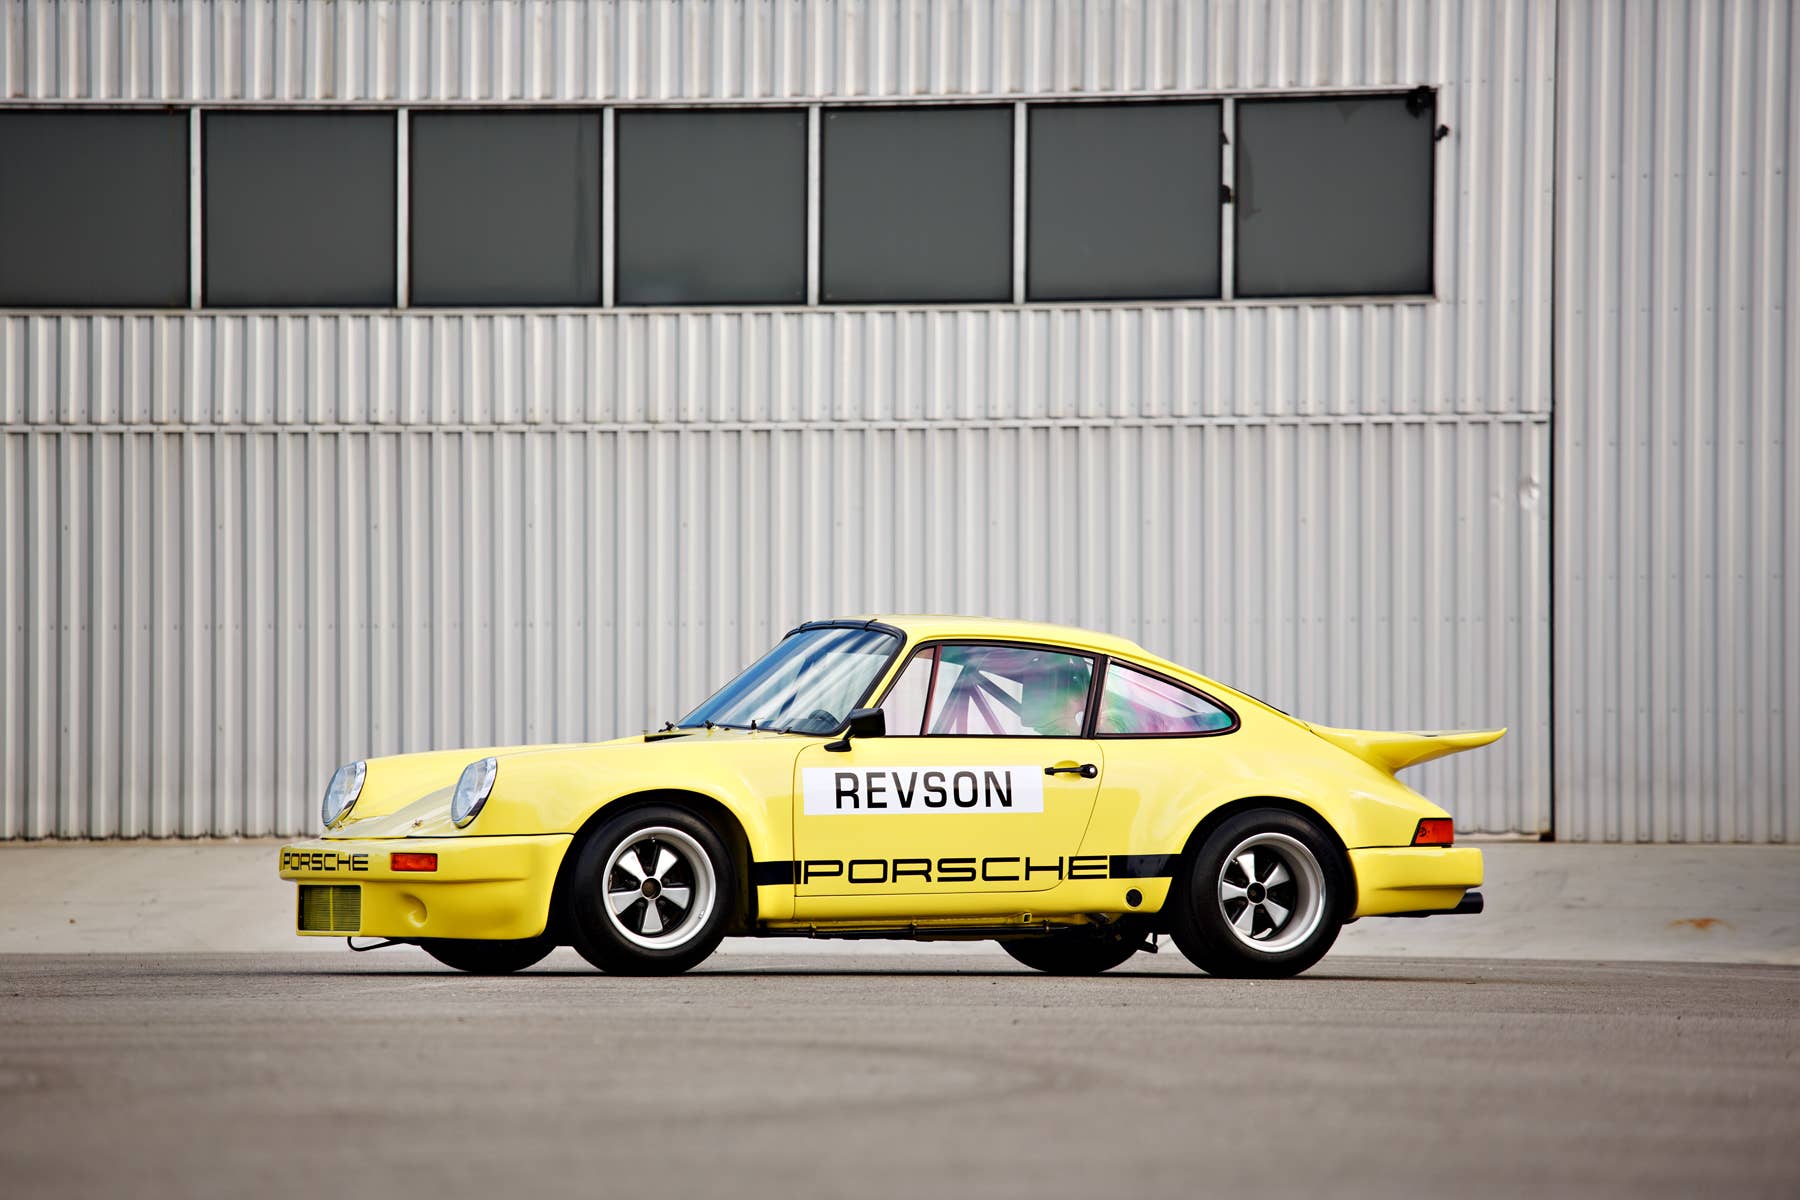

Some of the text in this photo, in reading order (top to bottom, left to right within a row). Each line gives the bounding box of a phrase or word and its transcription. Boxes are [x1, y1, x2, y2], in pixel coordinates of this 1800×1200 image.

[834, 770, 1013, 809] REVSON
[283, 853, 369, 871] PORSCHE
[803, 855, 1108, 885] PORSCHE
